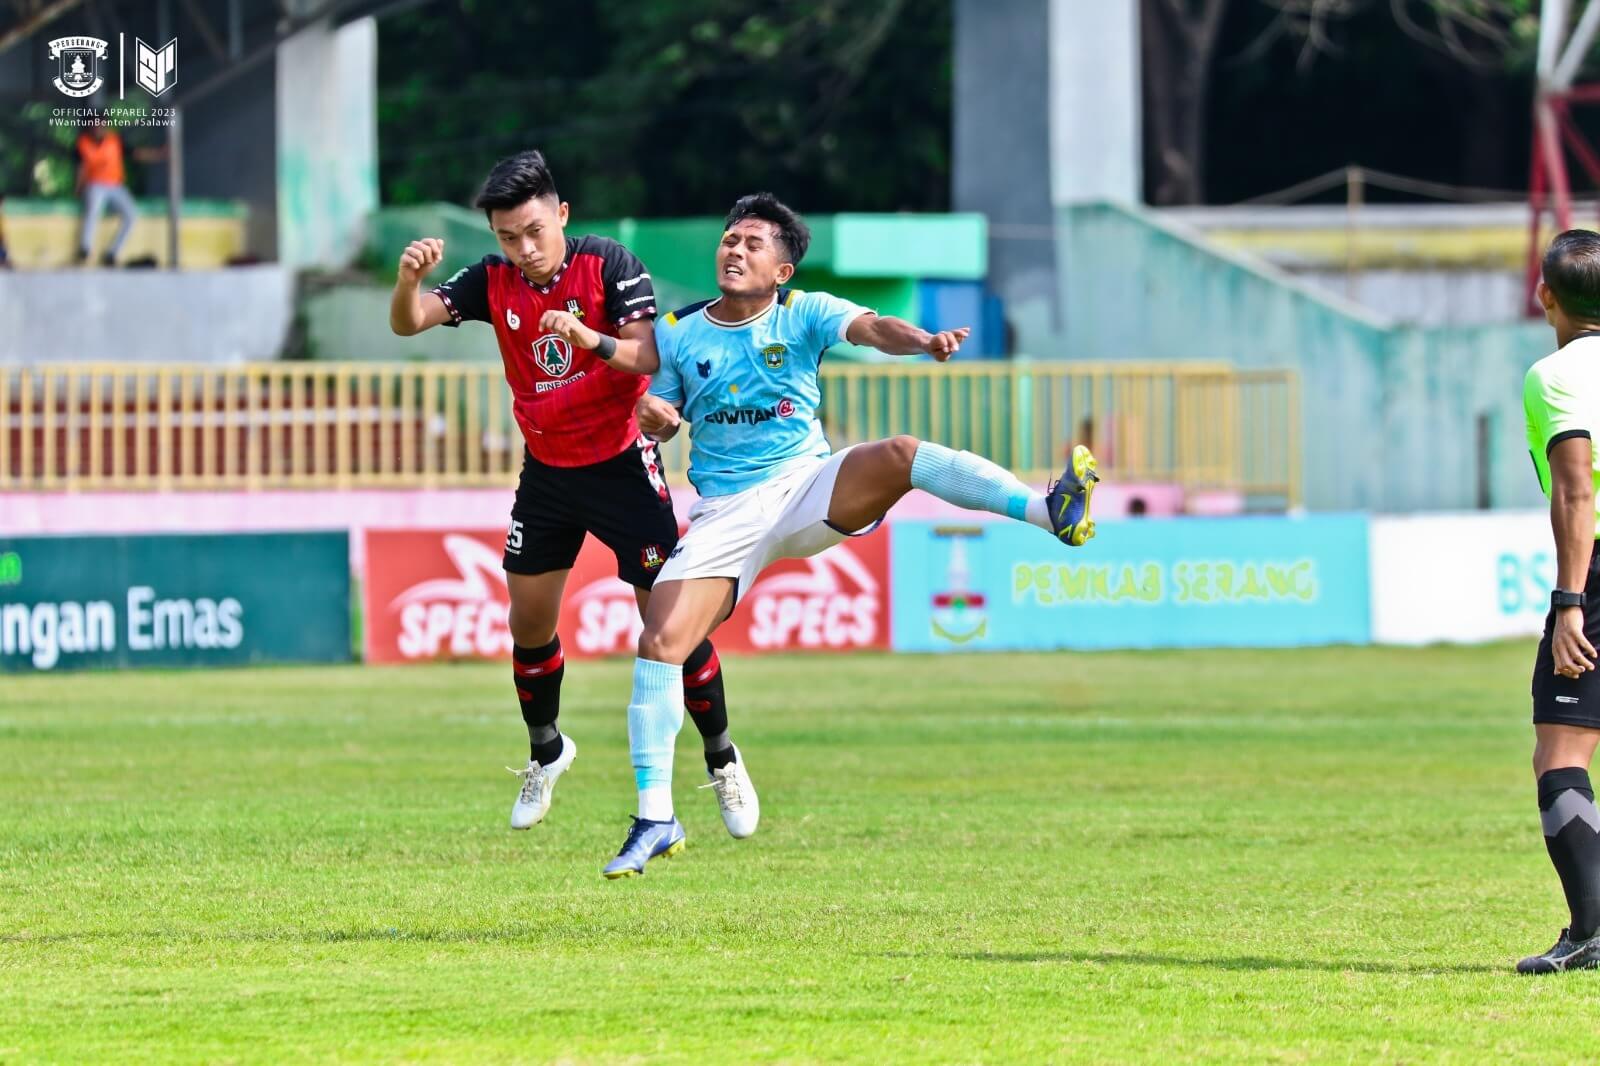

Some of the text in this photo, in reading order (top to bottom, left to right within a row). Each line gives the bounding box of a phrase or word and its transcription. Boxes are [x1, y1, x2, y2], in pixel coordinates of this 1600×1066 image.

[1173, 560, 1316, 602] SERANG
[127, 586, 244, 650] Emas
[398, 601, 514, 658] SPEC
[749, 594, 878, 648] SPECS
